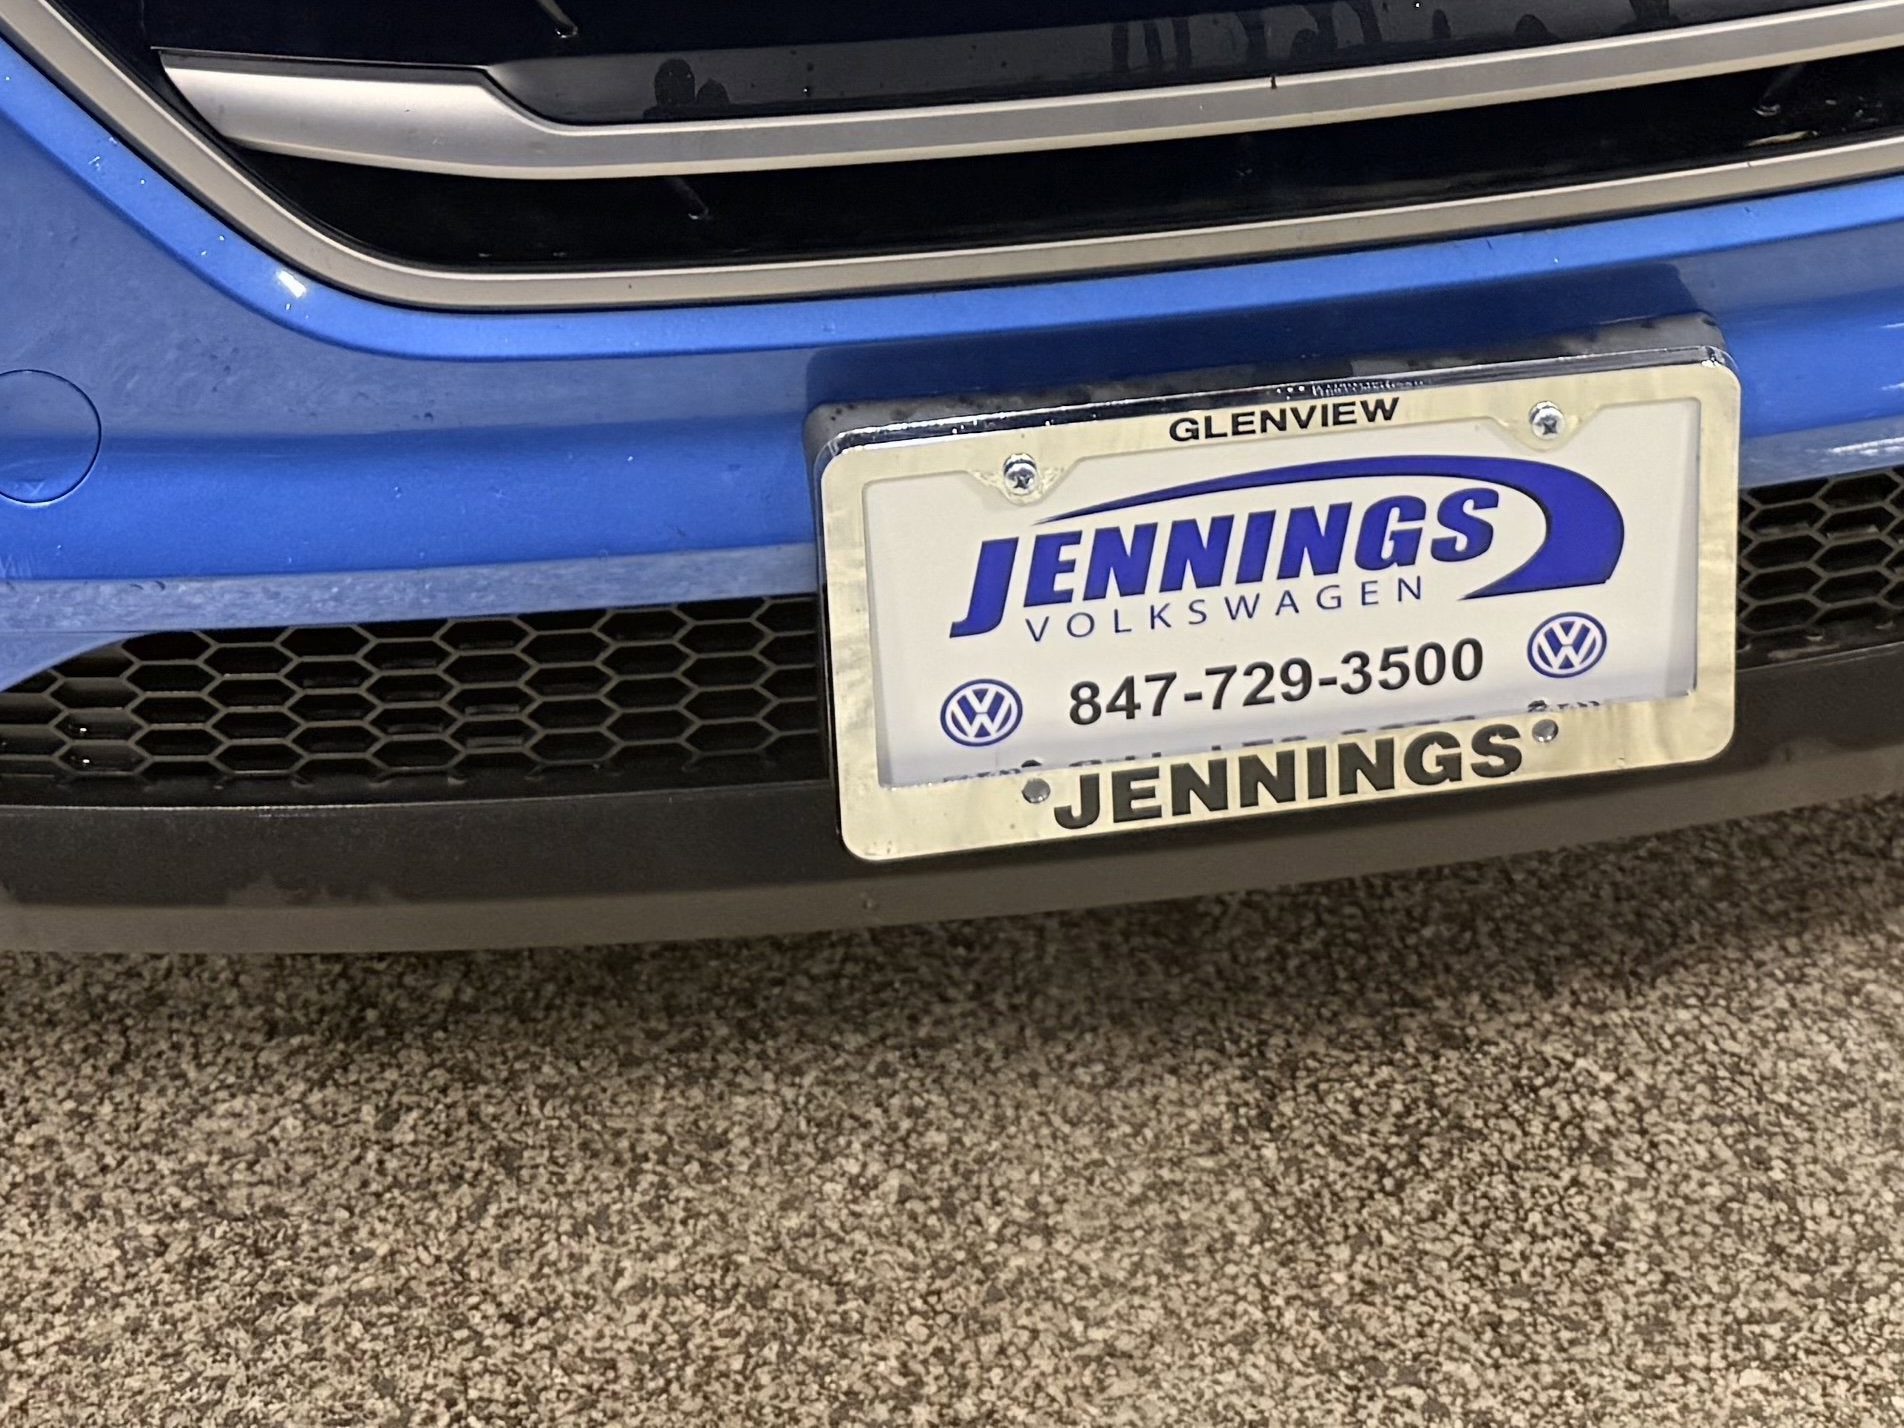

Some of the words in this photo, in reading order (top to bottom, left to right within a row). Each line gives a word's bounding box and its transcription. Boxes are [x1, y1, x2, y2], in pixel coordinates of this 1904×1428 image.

[1169, 397, 1400, 442] GLENVIEW
[949, 487, 1500, 638] JENNINGS
[1025, 575, 1423, 642] VOLKSWAGEN
[1069, 637, 1484, 726] 847-729-3500
[1053, 722, 1523, 830] JENNINGS
